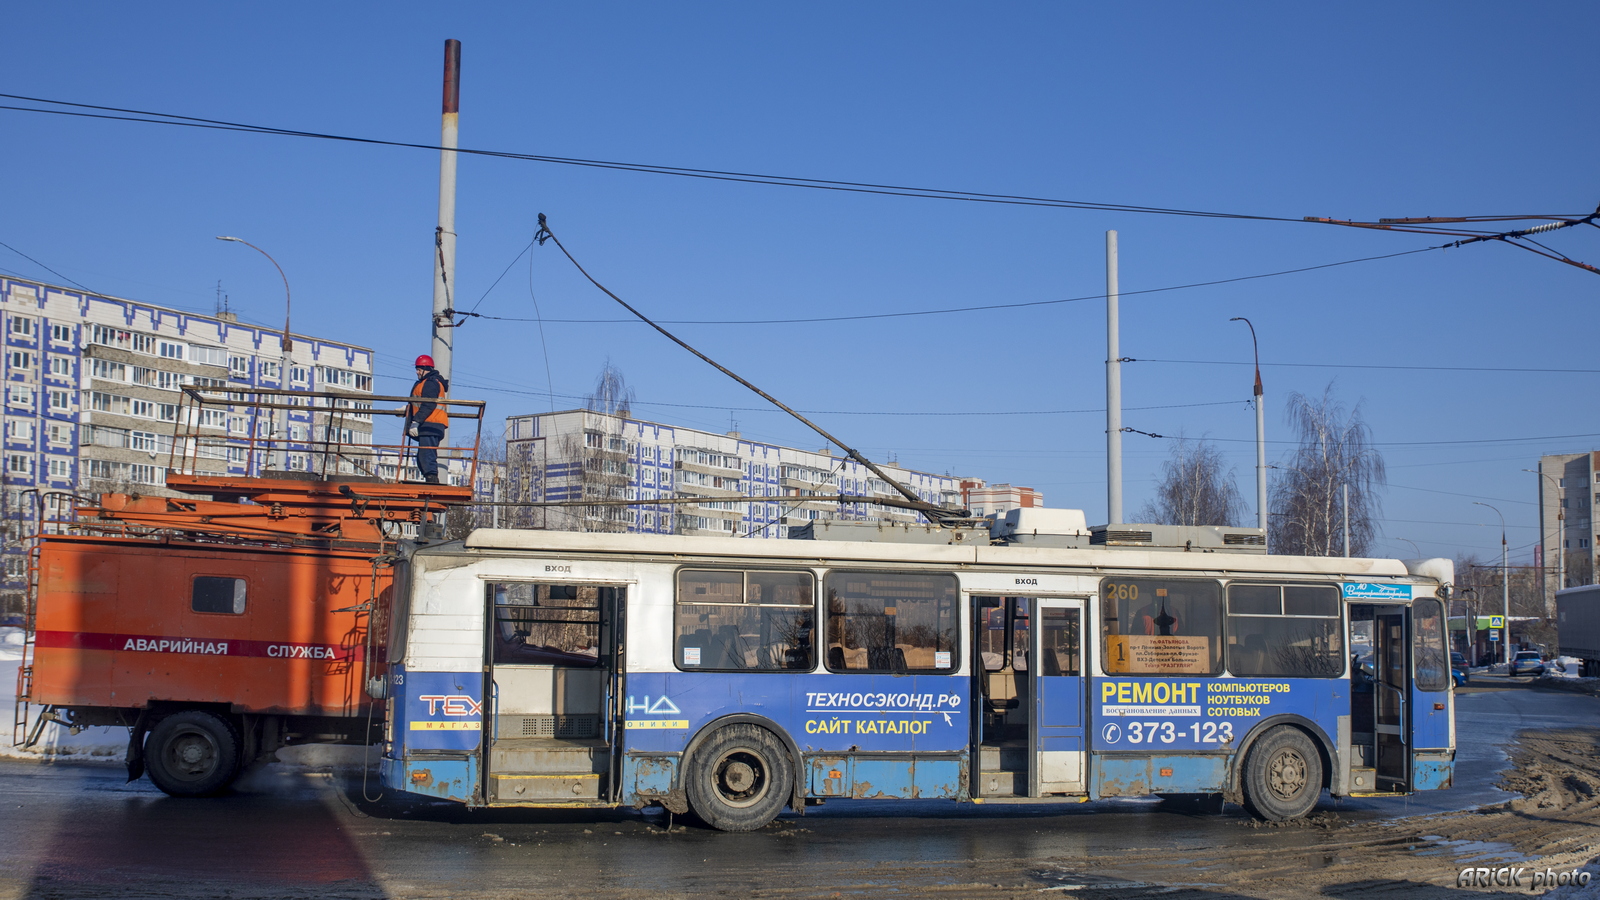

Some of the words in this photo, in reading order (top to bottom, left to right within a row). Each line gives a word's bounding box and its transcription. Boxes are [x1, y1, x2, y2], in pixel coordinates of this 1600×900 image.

[544, 565, 571, 573] ВХОД
[1014, 578, 1038, 586] ВХОД
[1107, 583, 1139, 600] 260
[123, 638, 228, 655] АВАРИЙНАЯ
[266, 645, 336, 659] СЛУЖБА
[1116, 642, 1125, 661] 1
[1102, 682, 1201, 704] РЕМОНТ
[1207, 683, 1291, 693] КОМПЬЮТЕРОВ
[626, 695, 681, 715] НД
[805, 692, 961, 711] ТЕХНОСЭКОНД.РФ
[1207, 695, 1271, 705] НОУТБУКОВ
[1105, 706, 1167, 714] восстановление
[1168, 707, 1198, 715] данных
[1207, 707, 1261, 717] СОТОВЫХ
[805, 717, 851, 734] САЙТ
[856, 720, 932, 735] КАТАЛОГ
[1127, 721, 1234, 744] 373-123
